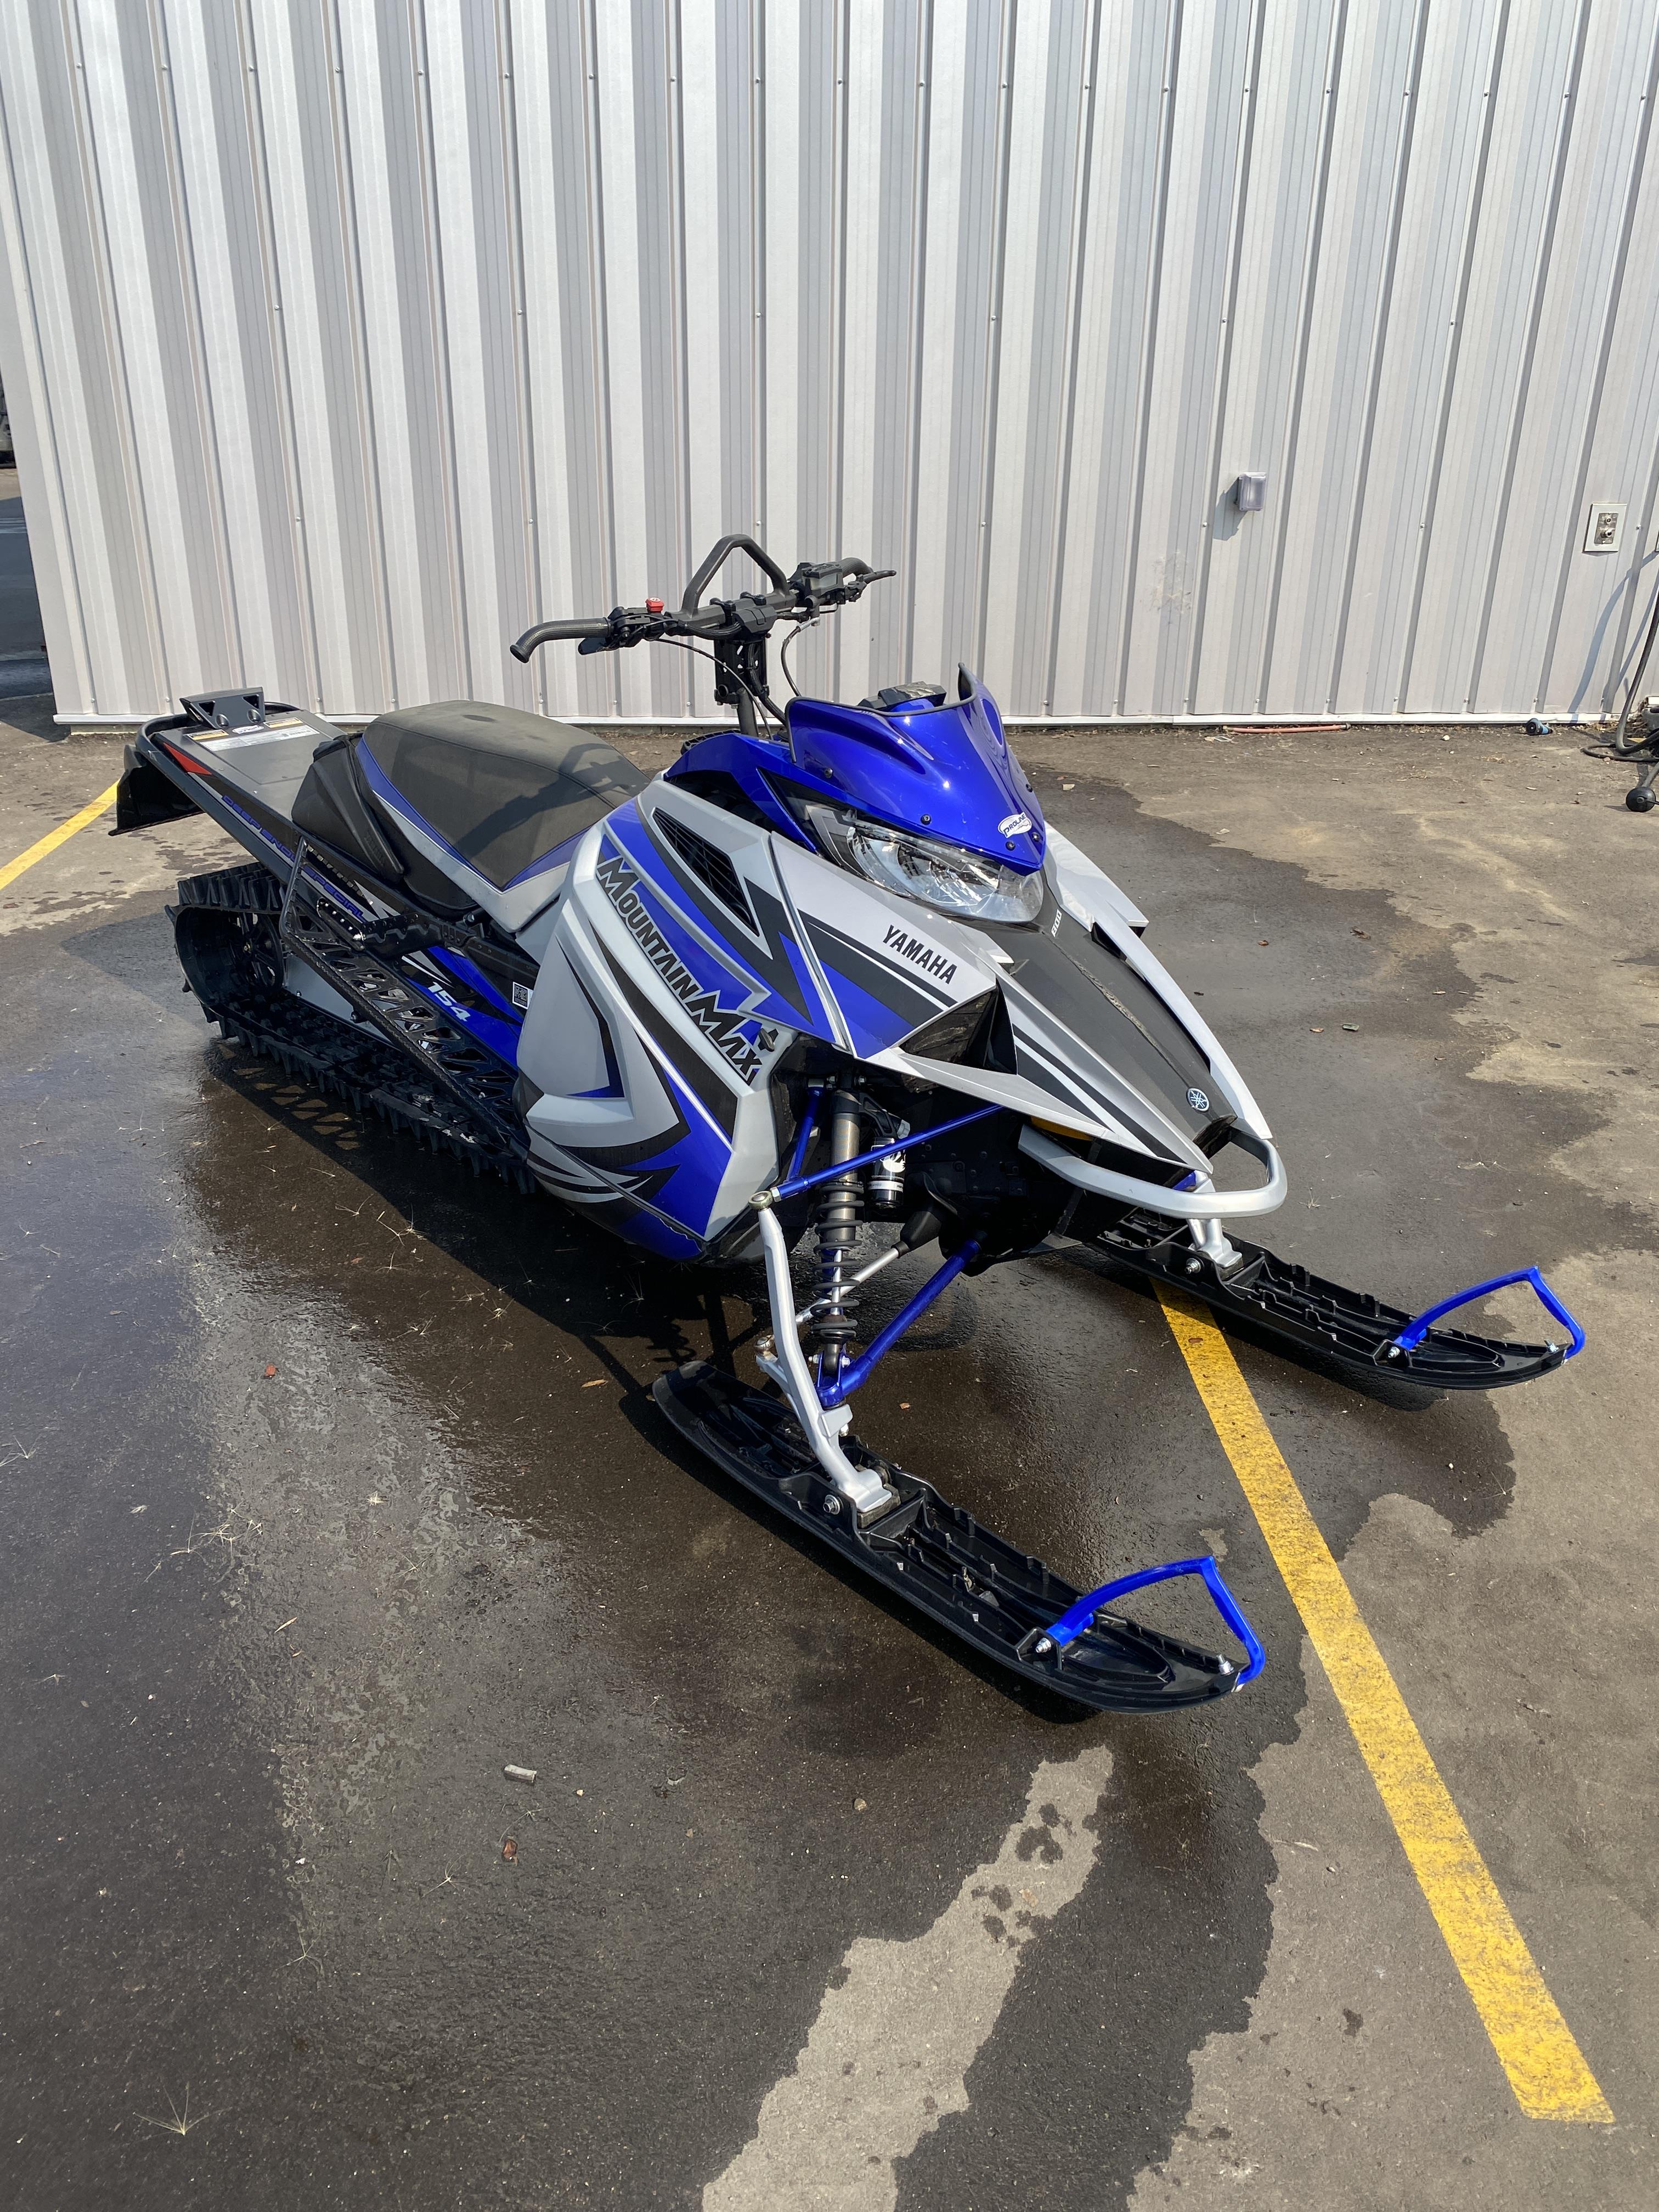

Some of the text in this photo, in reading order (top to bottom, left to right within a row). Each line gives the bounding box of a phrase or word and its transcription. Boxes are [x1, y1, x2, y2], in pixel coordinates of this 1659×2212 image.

[1003, 814, 1026, 837] PROLINE
[222, 795, 261, 830] DEEP
[303, 865, 367, 924] SPECIAL
[1051, 909, 1062, 938] 800
[596, 856, 763, 1077] MOUNTAIN MAX
[882, 924, 958, 985] YAMAHA
[427, 981, 471, 1022] 154
